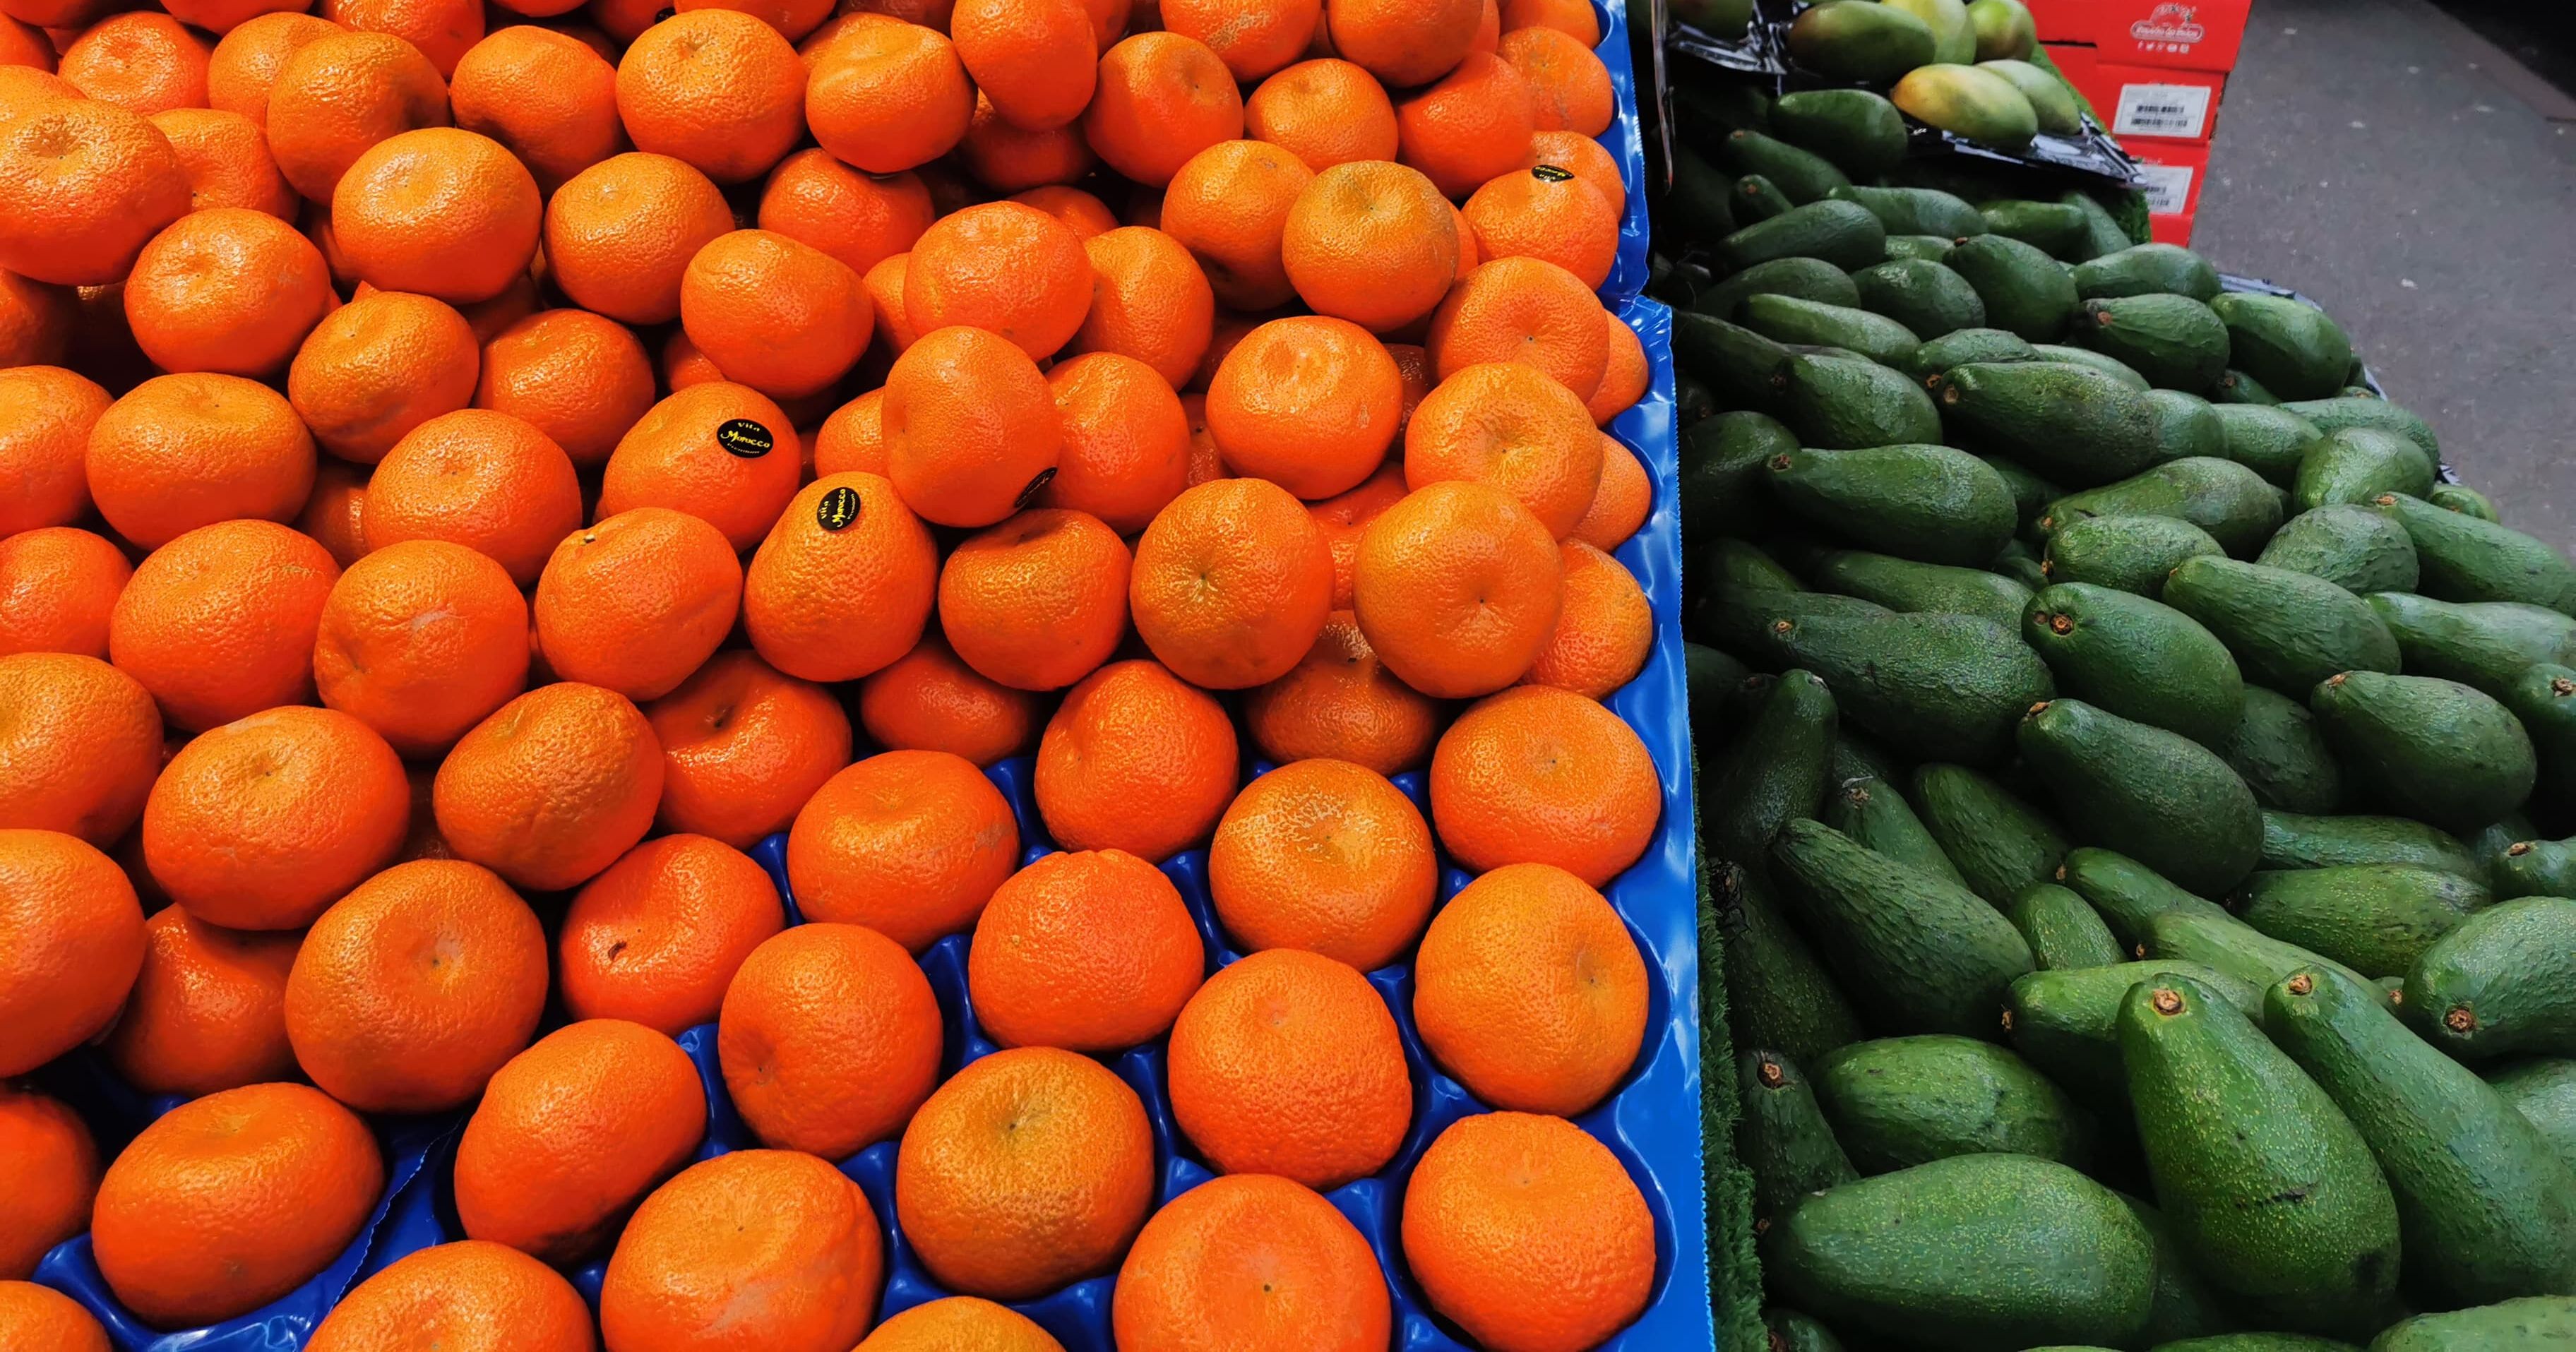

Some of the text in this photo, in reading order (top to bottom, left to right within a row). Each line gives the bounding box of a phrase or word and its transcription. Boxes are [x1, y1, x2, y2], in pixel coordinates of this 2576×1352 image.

[737, 421, 761, 432] Vita
[720, 430, 770, 448] Morocco
[831, 489, 846, 527] Morocco
